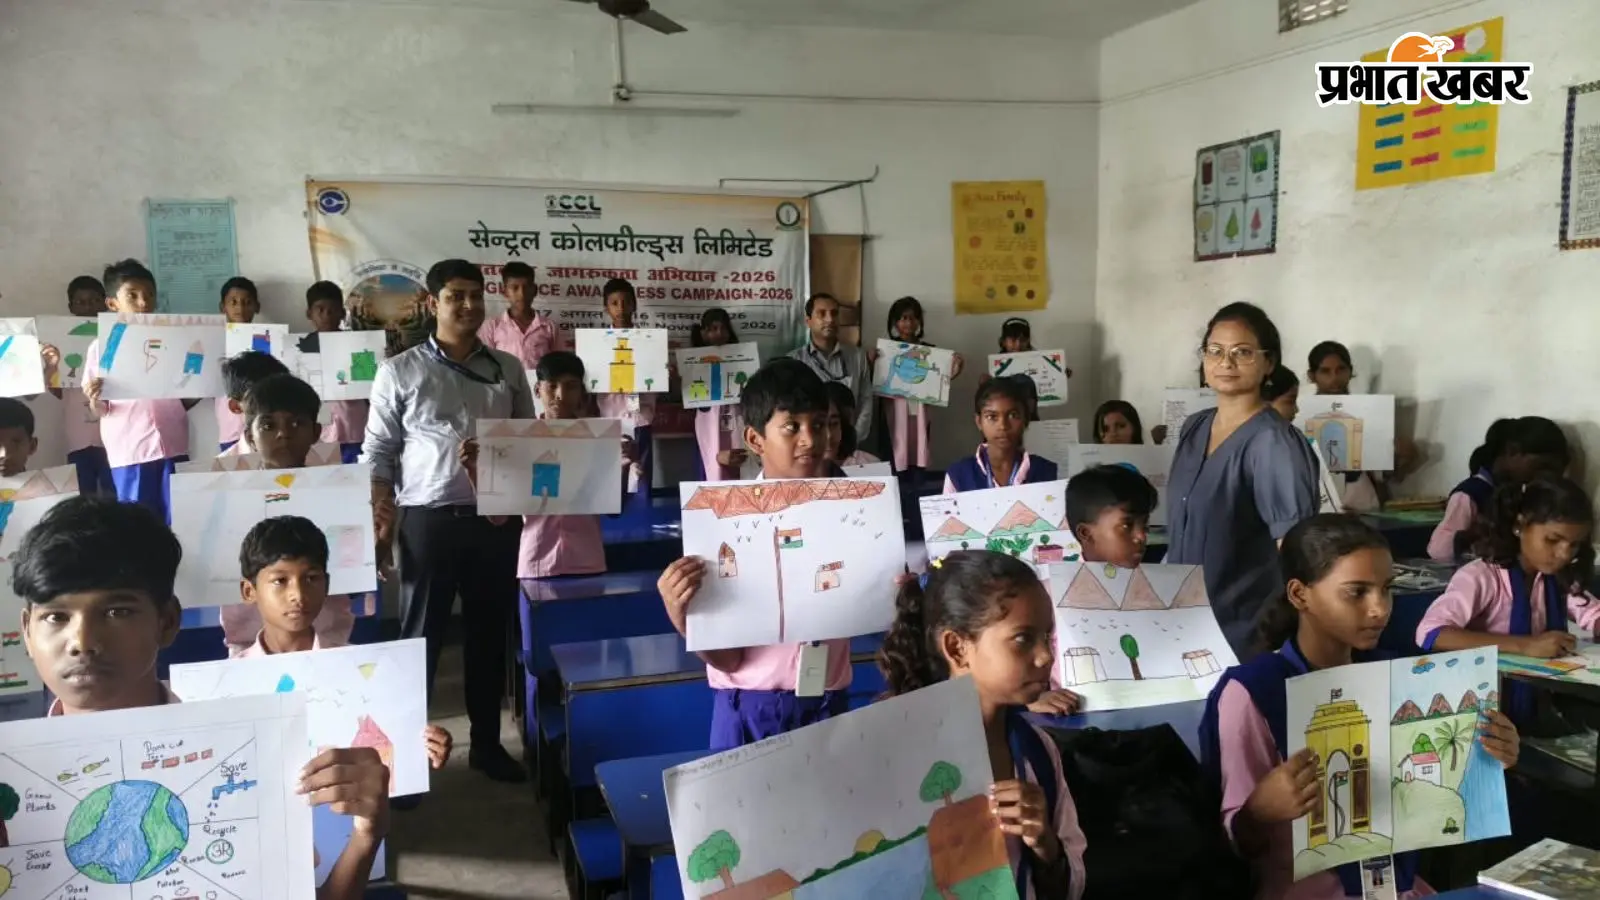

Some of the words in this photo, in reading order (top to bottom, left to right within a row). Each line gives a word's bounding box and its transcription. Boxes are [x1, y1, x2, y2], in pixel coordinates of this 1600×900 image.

[559, 194, 602, 210] CCL
[468, 220, 540, 256] सेन्ट्रल
[550, 223, 684, 261] कोलफील्ड्स
[693, 227, 774, 258] लिमिटेड
[646, 266, 718, 282] अभियान
[566, 284, 665, 300] AWAESS
[670, 287, 794, 301] CAMPAIGN-2026
[740, 321, 777, 331] 2026
[220, 762, 248, 774] Save
